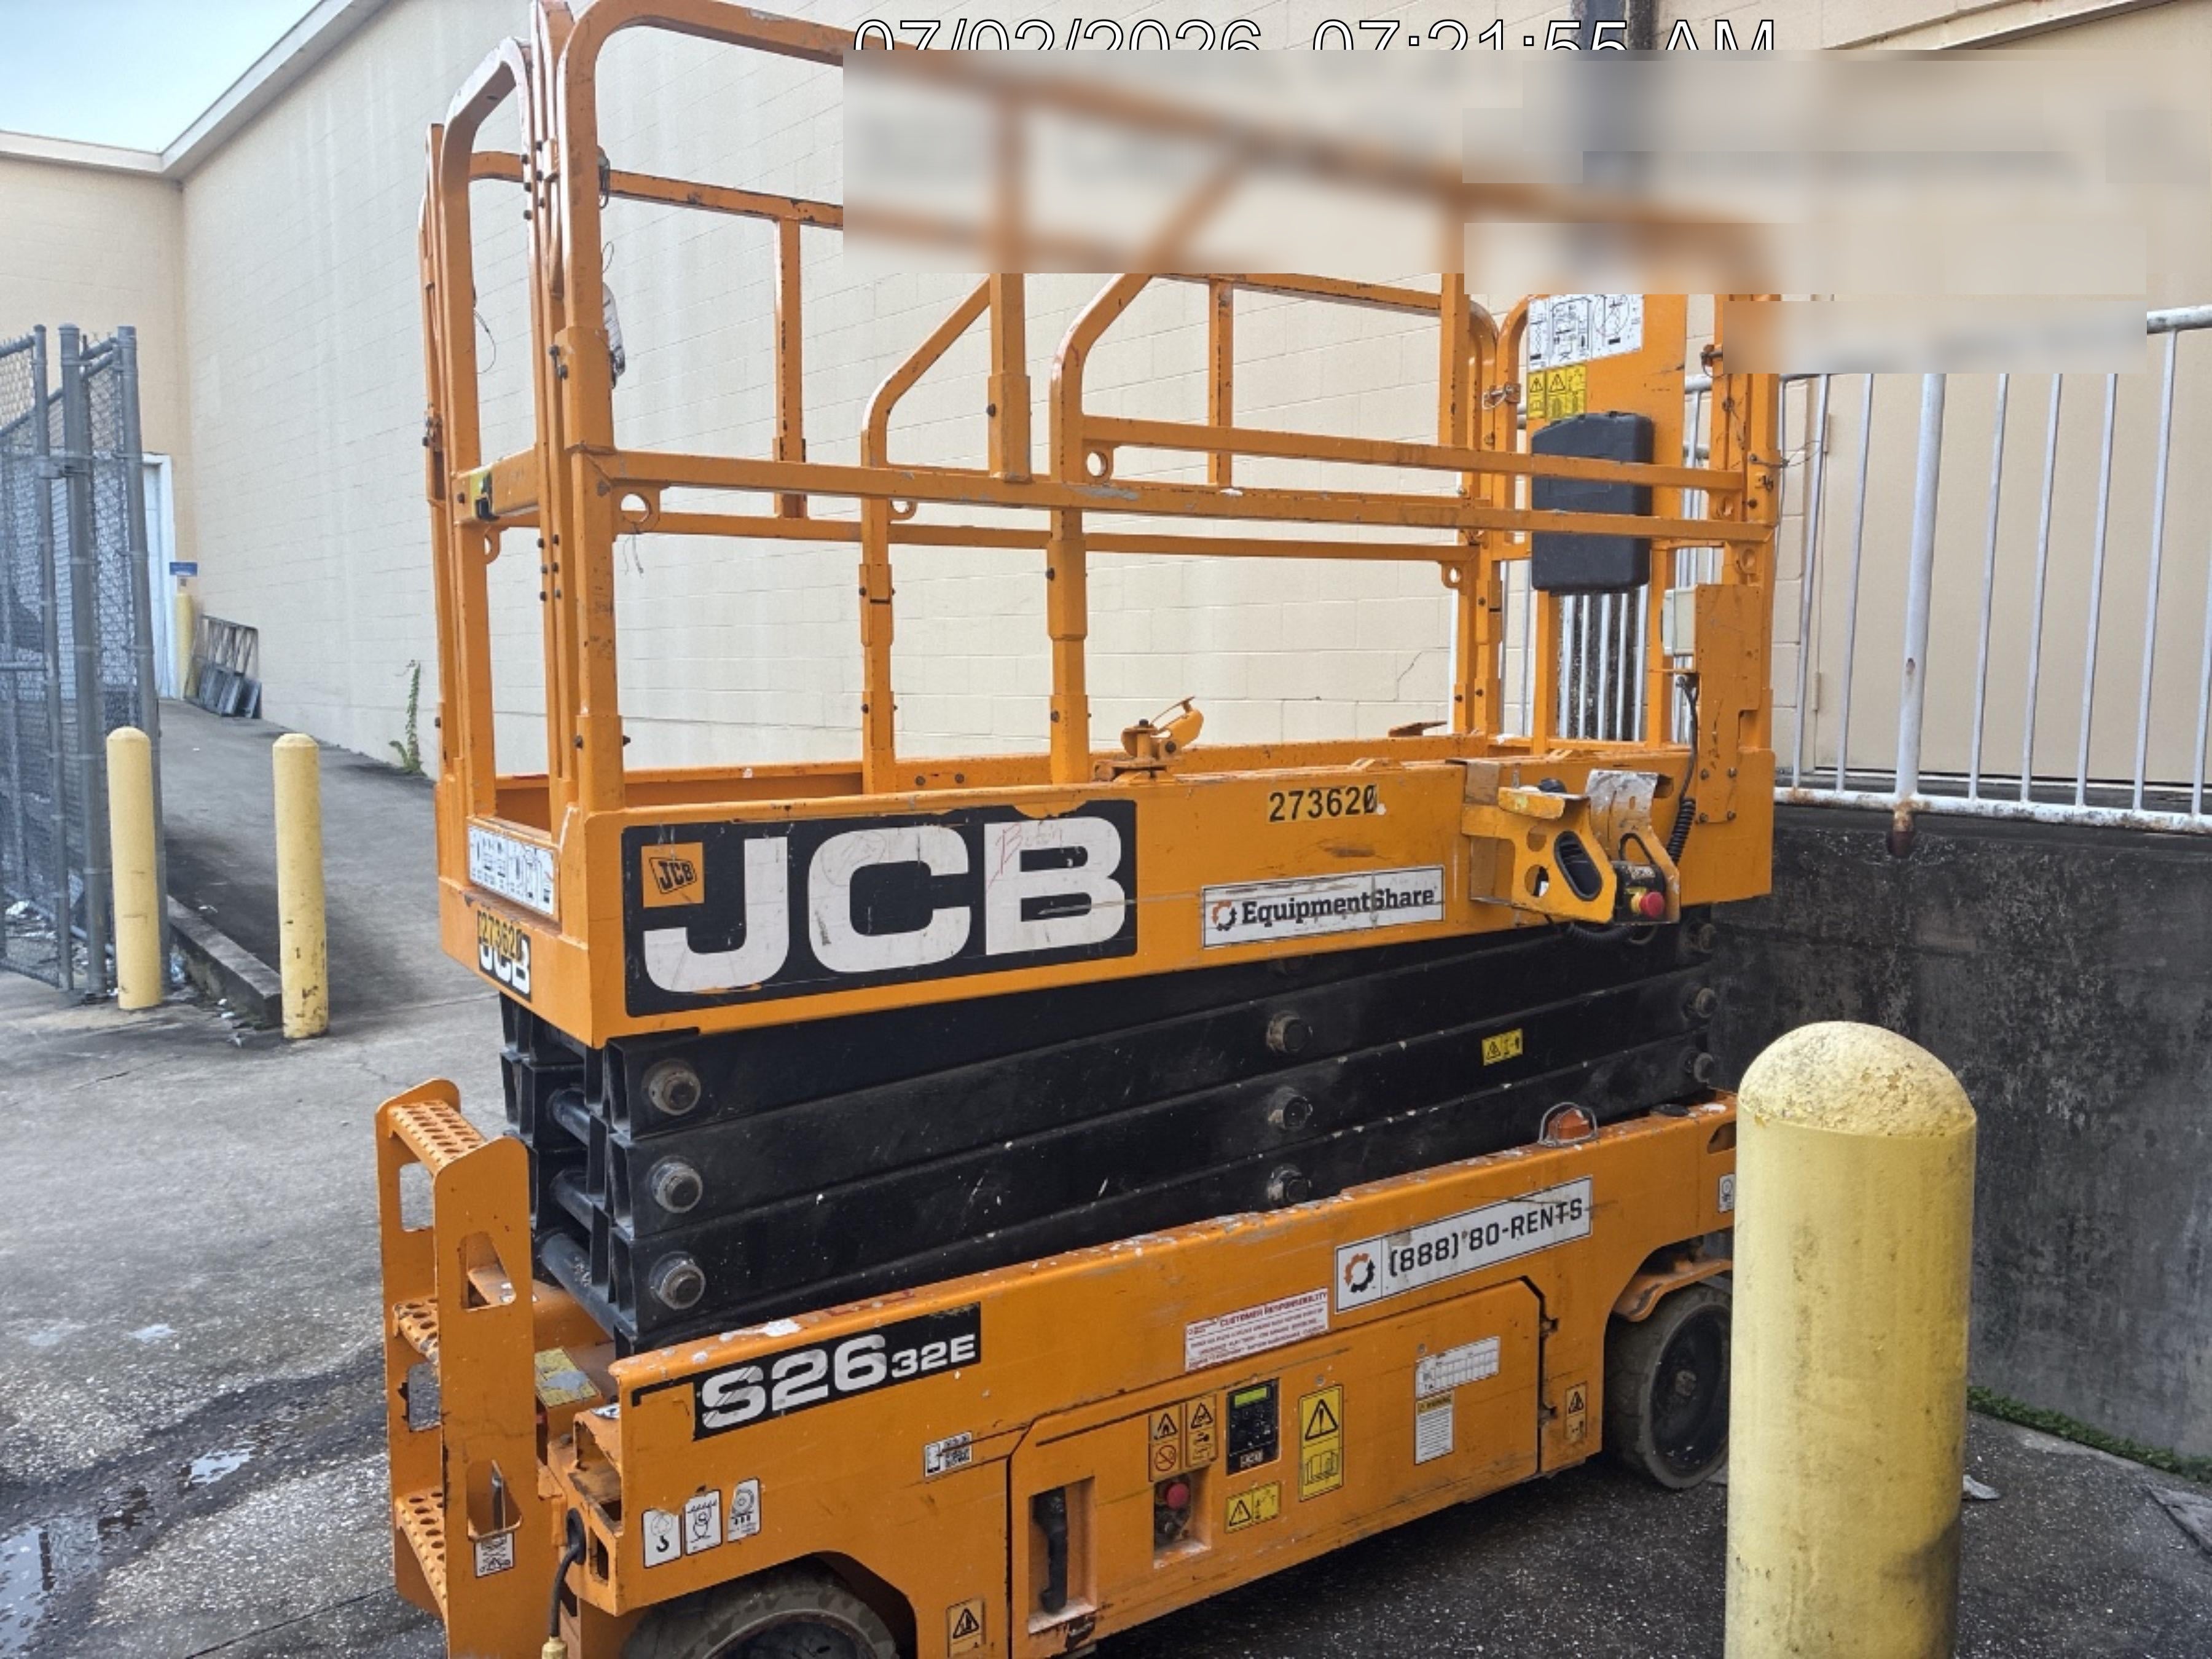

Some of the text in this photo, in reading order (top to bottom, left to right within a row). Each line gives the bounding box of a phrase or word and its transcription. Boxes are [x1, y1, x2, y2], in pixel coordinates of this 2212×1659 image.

[1269, 784, 1378, 823] 273620
[657, 860, 694, 890] JCB
[643, 816, 1126, 993] JCB
[1242, 888, 1435, 927] EquipmentShare
[701, 1333, 976, 1429] S26 32E
